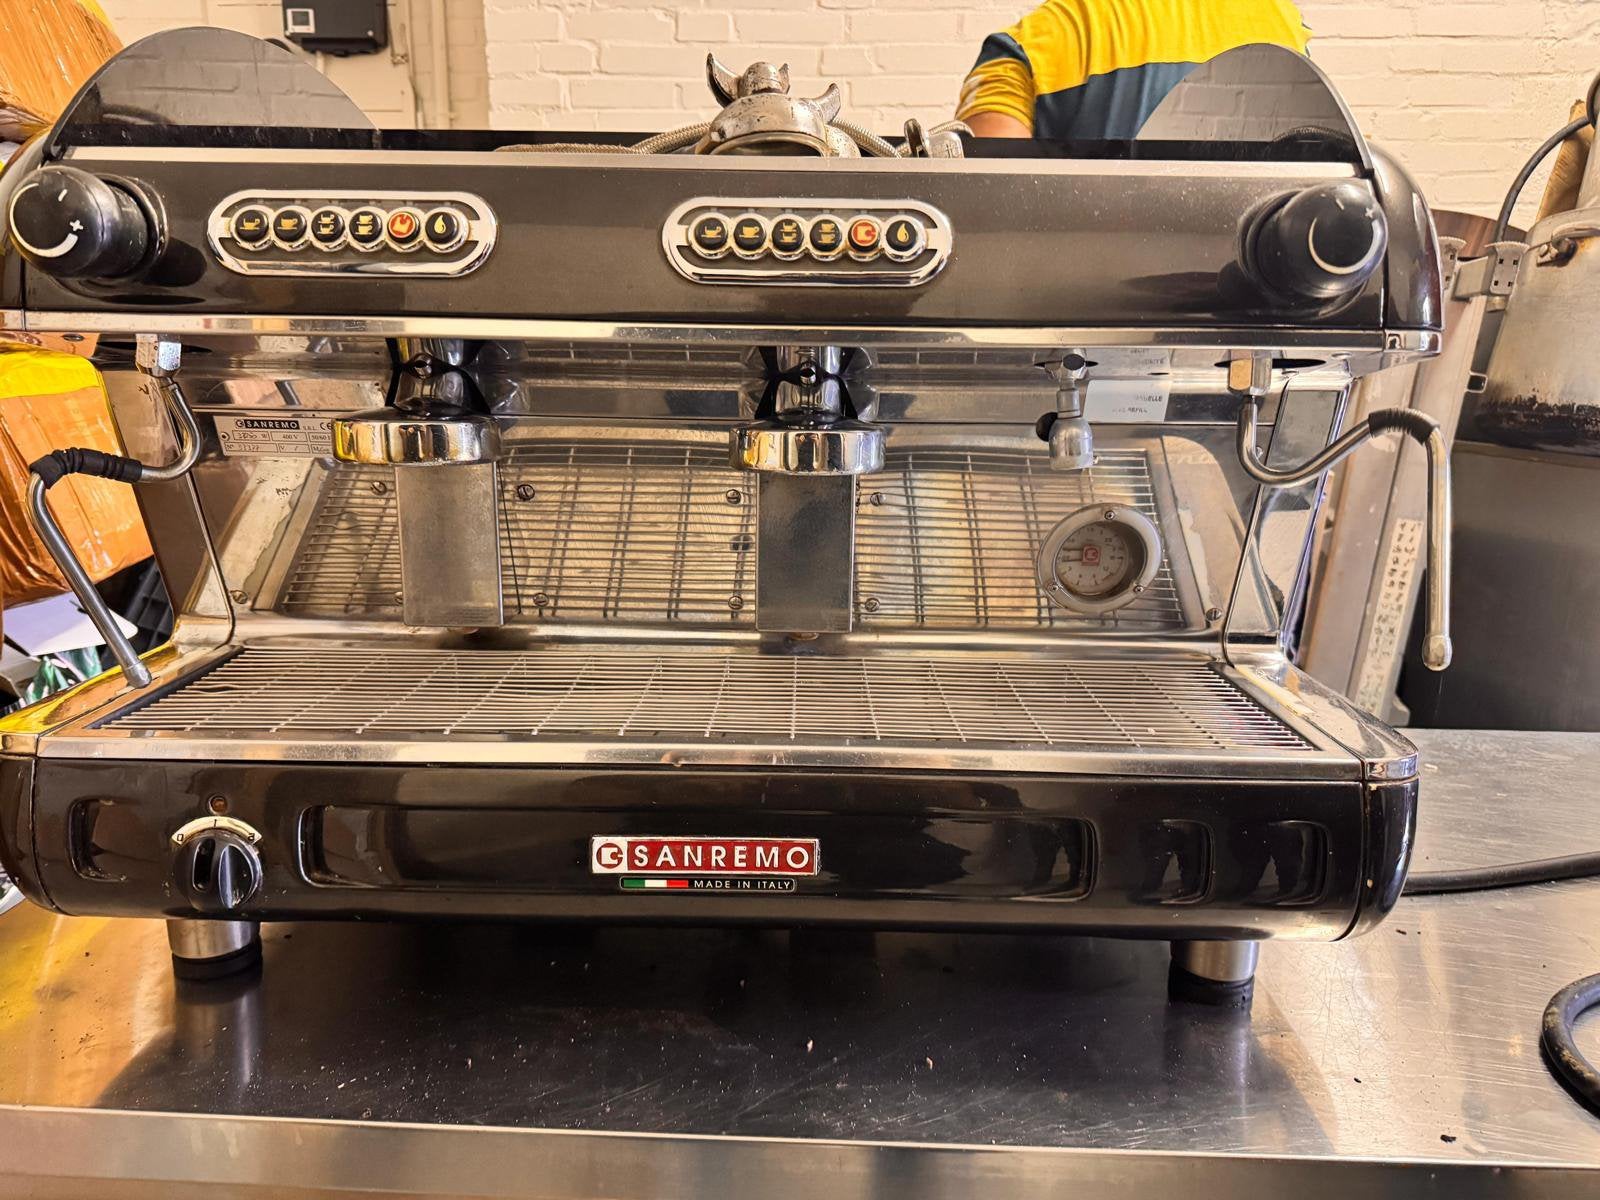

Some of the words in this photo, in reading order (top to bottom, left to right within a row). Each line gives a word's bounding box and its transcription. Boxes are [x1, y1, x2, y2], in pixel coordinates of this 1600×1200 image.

[246, 420, 298, 429] SANREMO
[633, 845, 810, 869] SANREMO
[694, 879, 732, 889] MADE
[737, 880, 752, 889] IN
[757, 880, 792, 890] ITALY
